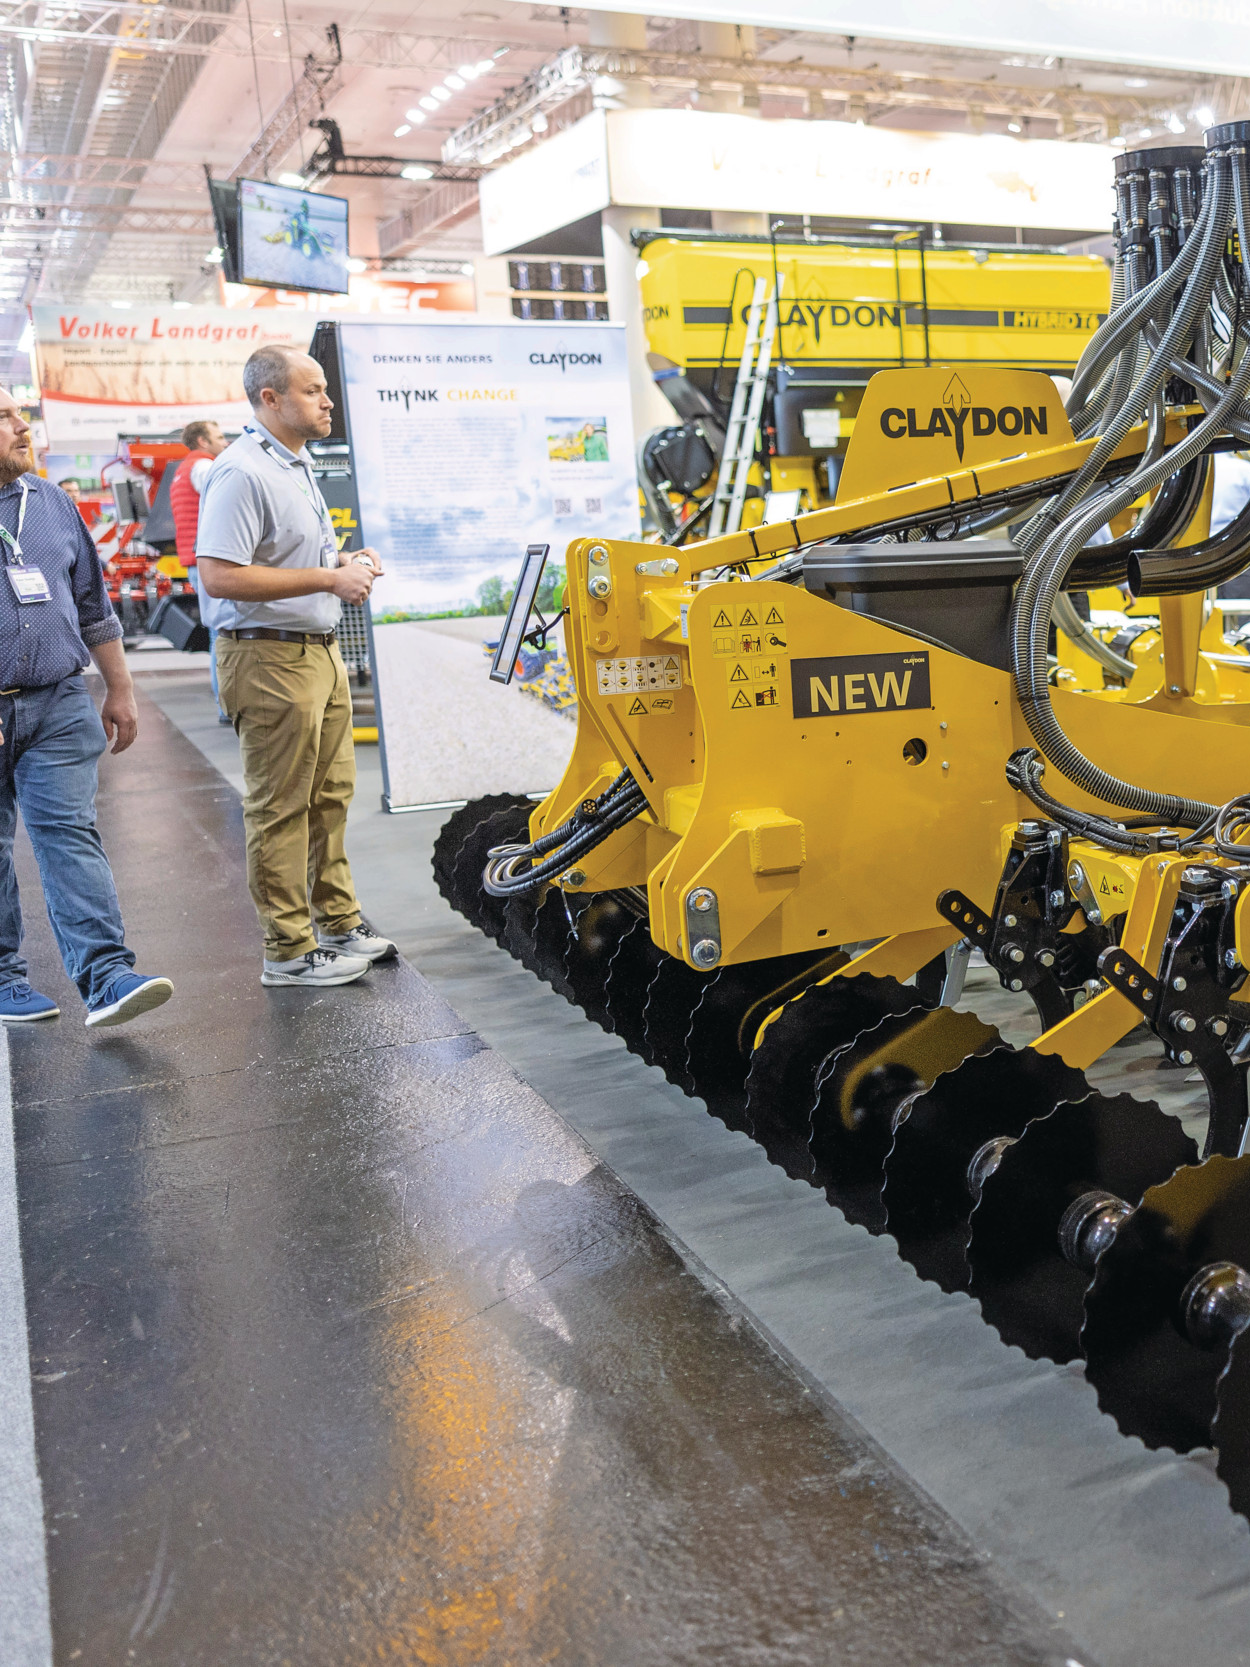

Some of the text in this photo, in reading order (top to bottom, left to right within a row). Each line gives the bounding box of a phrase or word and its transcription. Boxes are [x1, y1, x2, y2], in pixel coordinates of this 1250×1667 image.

[60, 316, 138, 338] Volker
[151, 318, 259, 342] Landgraf
[372, 354, 494, 364] DENKEN SIE ANDERS
[528, 353, 604, 373] CLAYDON
[376, 388, 520, 413] THYNK CHANGE
[880, 405, 1048, 464] CLAYDON
[903, 656, 925, 666] CLAYDON
[809, 670, 913, 713] NEW
